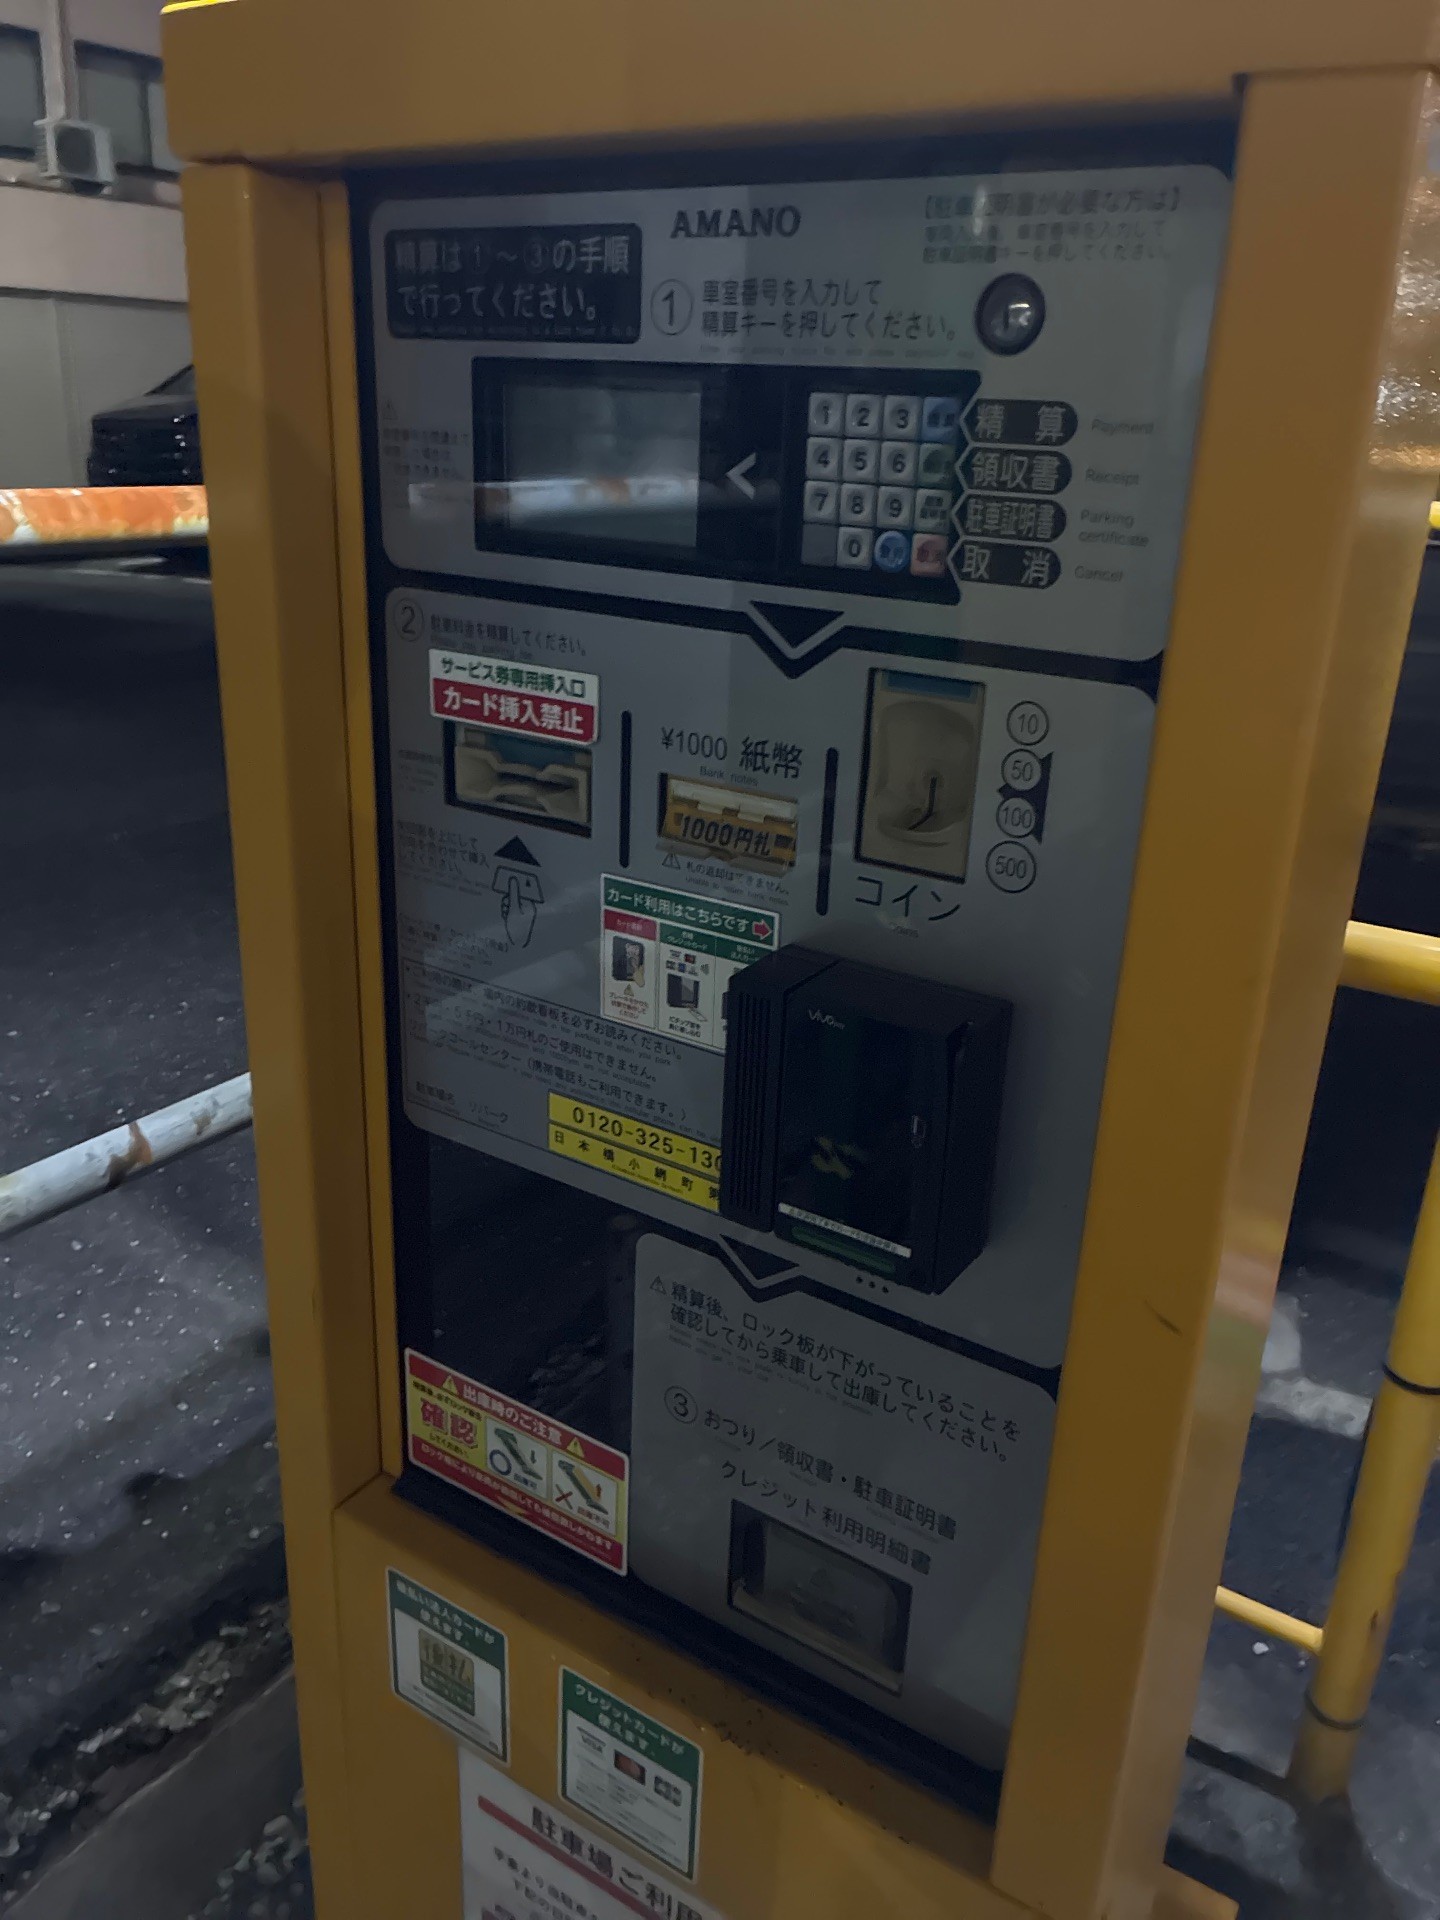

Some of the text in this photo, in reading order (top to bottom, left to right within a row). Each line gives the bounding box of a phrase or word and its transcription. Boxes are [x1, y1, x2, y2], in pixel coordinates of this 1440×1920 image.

[670, 205, 801, 238] AMANO
[398, 283, 595, 320] で行ってください。
[823, 405, 831, 426] 1
[857, 407, 870, 427] 2
[897, 408, 909, 429] 3
[817, 449, 831, 468] 4
[854, 451, 867, 471] 5
[892, 453, 906, 474] 6
[971, 452, 1060, 491] 領収書
[814, 491, 829, 511] 7
[851, 495, 864, 515] 8
[889, 498, 902, 518] 9
[966, 498, 1055, 539] 駐車証明書
[848, 538, 861, 558] 0
[442, 656, 586, 699] サービス券専用挿入口
[442, 686, 585, 735] カード挿入禁止
[1016, 713, 1039, 736] 10
[660, 725, 804, 780] ¥1000 紙幣
[1011, 759, 1035, 783] 50
[1002, 806, 1033, 830] 100
[681, 814, 772, 857] 1000円札
[995, 855, 1028, 880] 500
[607, 888, 750, 933] カード利用はこちらです
[854, 875, 962, 922] コイン
[669, 1304, 1008, 1463] 確認してから乗車して出庫してください。
[721, 1460, 933, 1576] クレジット利用明細書
